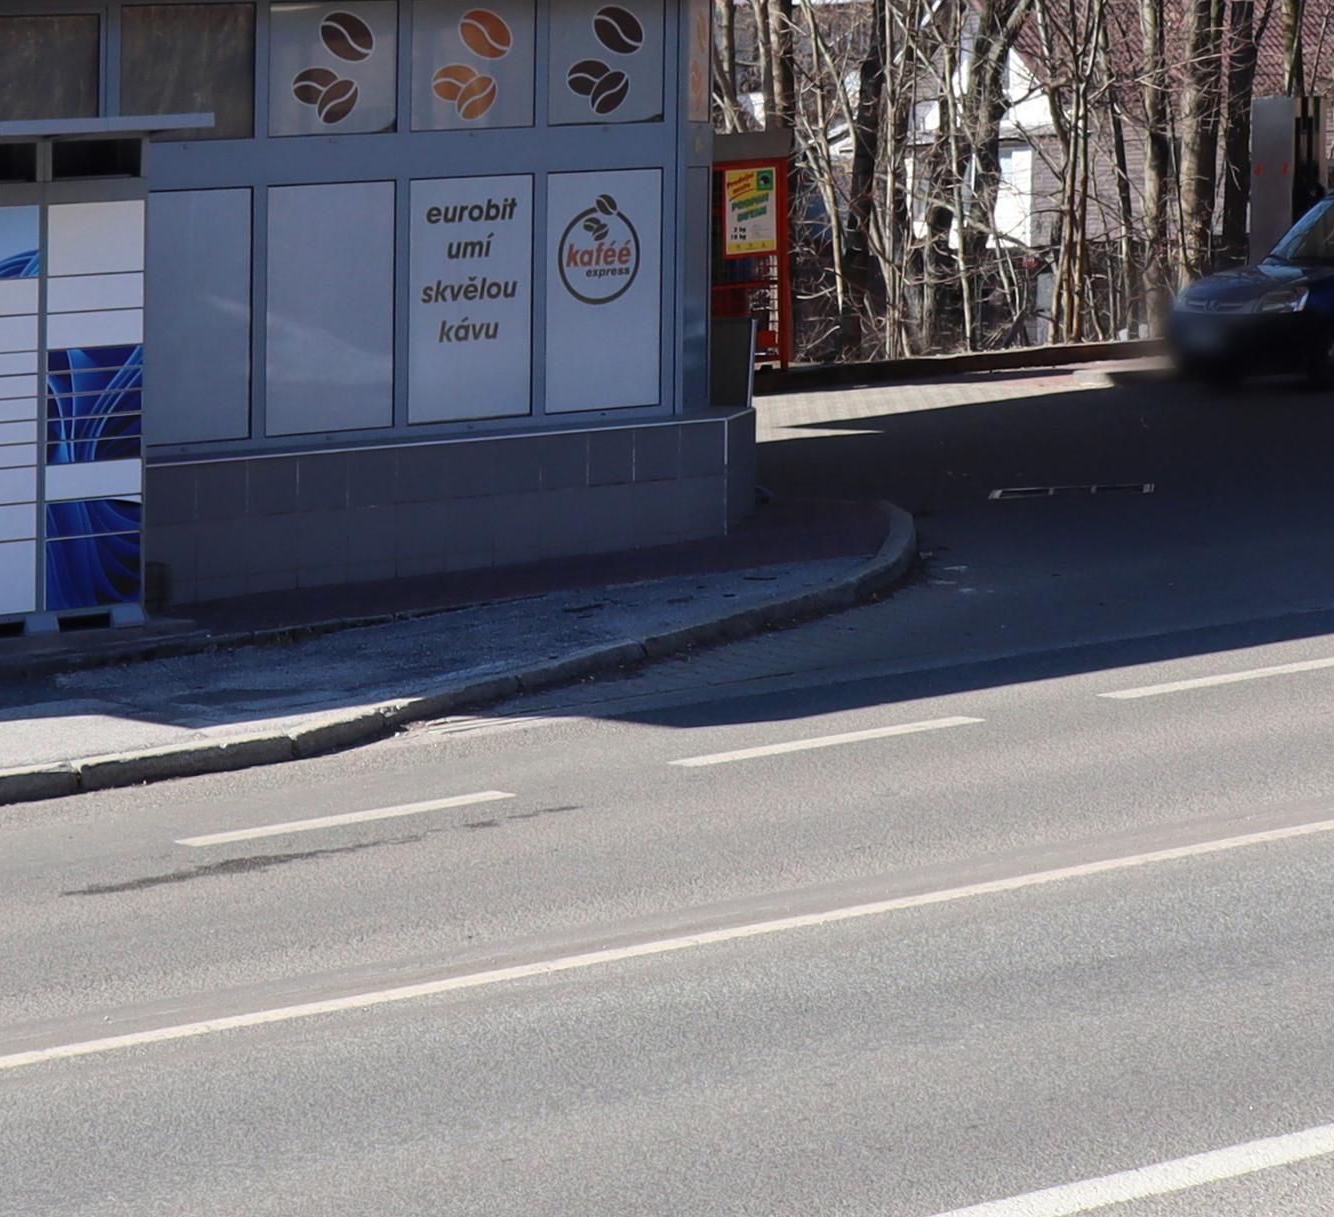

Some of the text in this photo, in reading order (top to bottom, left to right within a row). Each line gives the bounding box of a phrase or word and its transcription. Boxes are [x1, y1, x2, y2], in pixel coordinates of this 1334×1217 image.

[425, 197, 517, 225] eurobit
[446, 233, 494, 260] umí
[585, 267, 631, 280] express
[421, 276, 517, 304] skvělou
[438, 317, 499, 343] kávu
